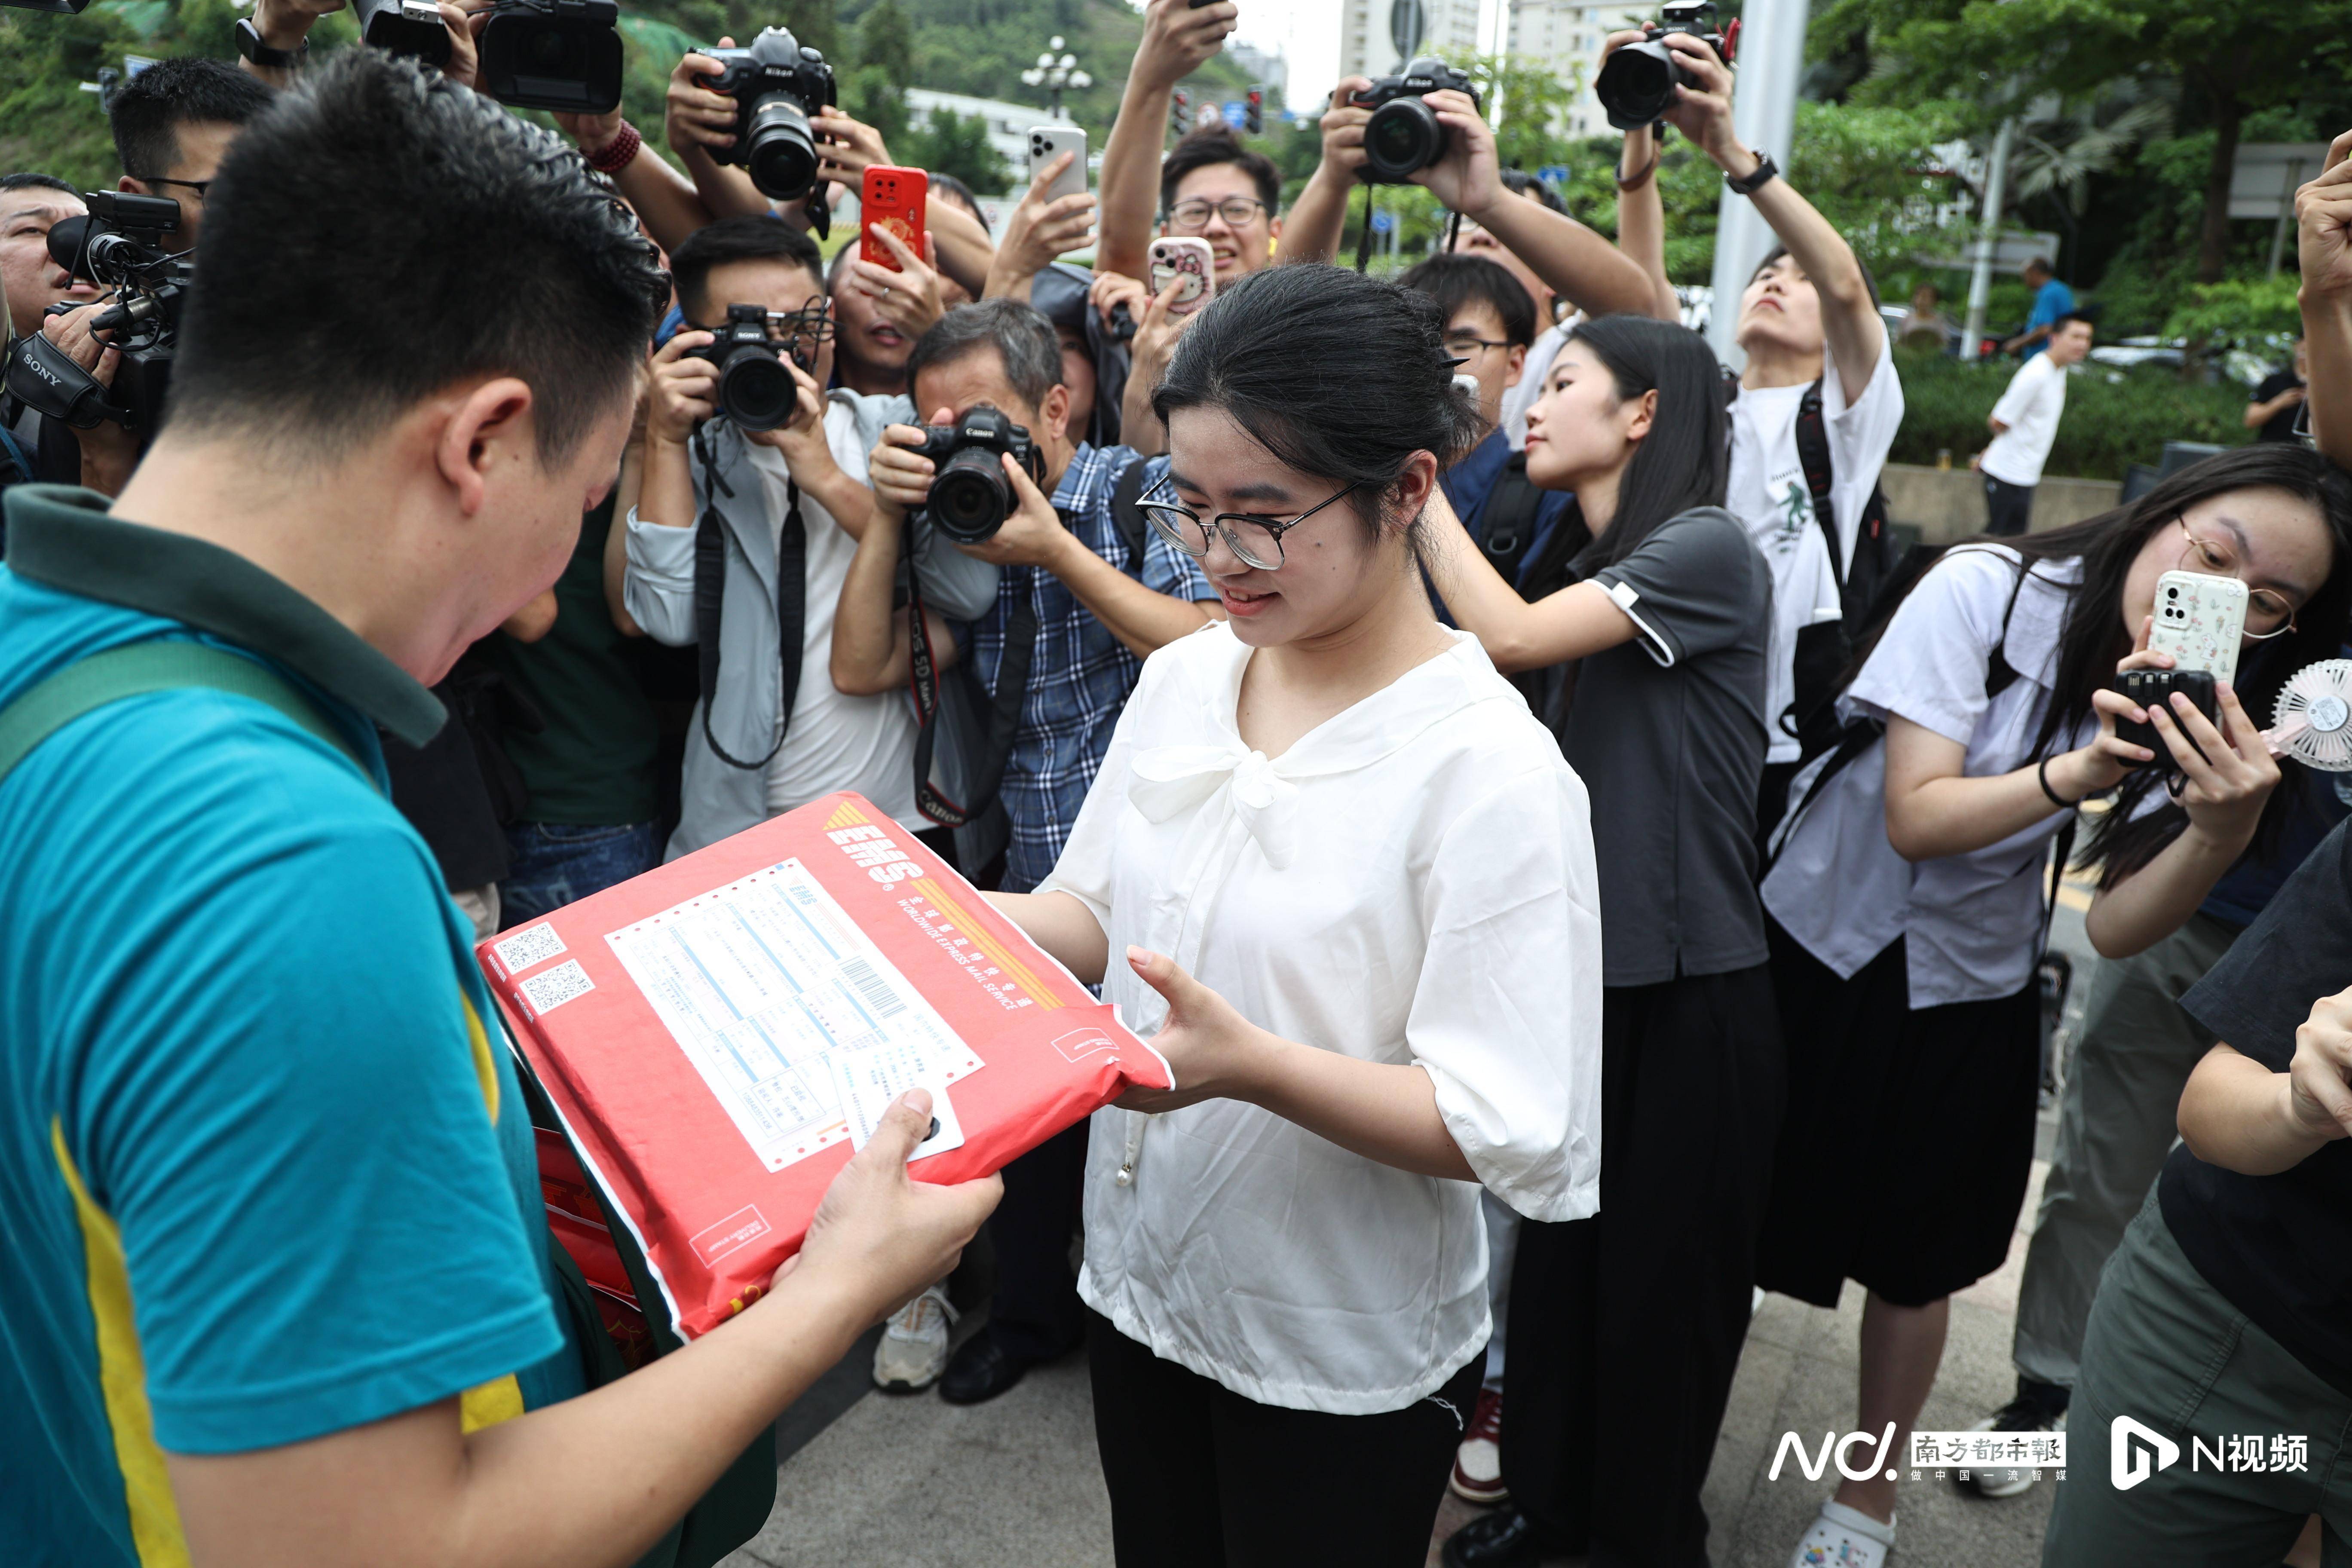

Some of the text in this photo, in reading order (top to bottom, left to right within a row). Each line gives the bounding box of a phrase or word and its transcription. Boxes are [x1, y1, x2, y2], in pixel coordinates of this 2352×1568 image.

[765, 66, 794, 78] Nikon
[23, 353, 62, 386] SONY
[965, 428, 995, 438] Canon
[919, 789, 963, 823] Canon
[826, 825, 924, 884] EMS
[897, 898, 1019, 1010] WORLDWIDE EXPRESS MAIL SERVICE
[908, 895, 1033, 1008] 全球邮政特快专递
[913, 1013, 951, 1052] 国内特快专递
[790, 1086, 805, 1101] 已验视
